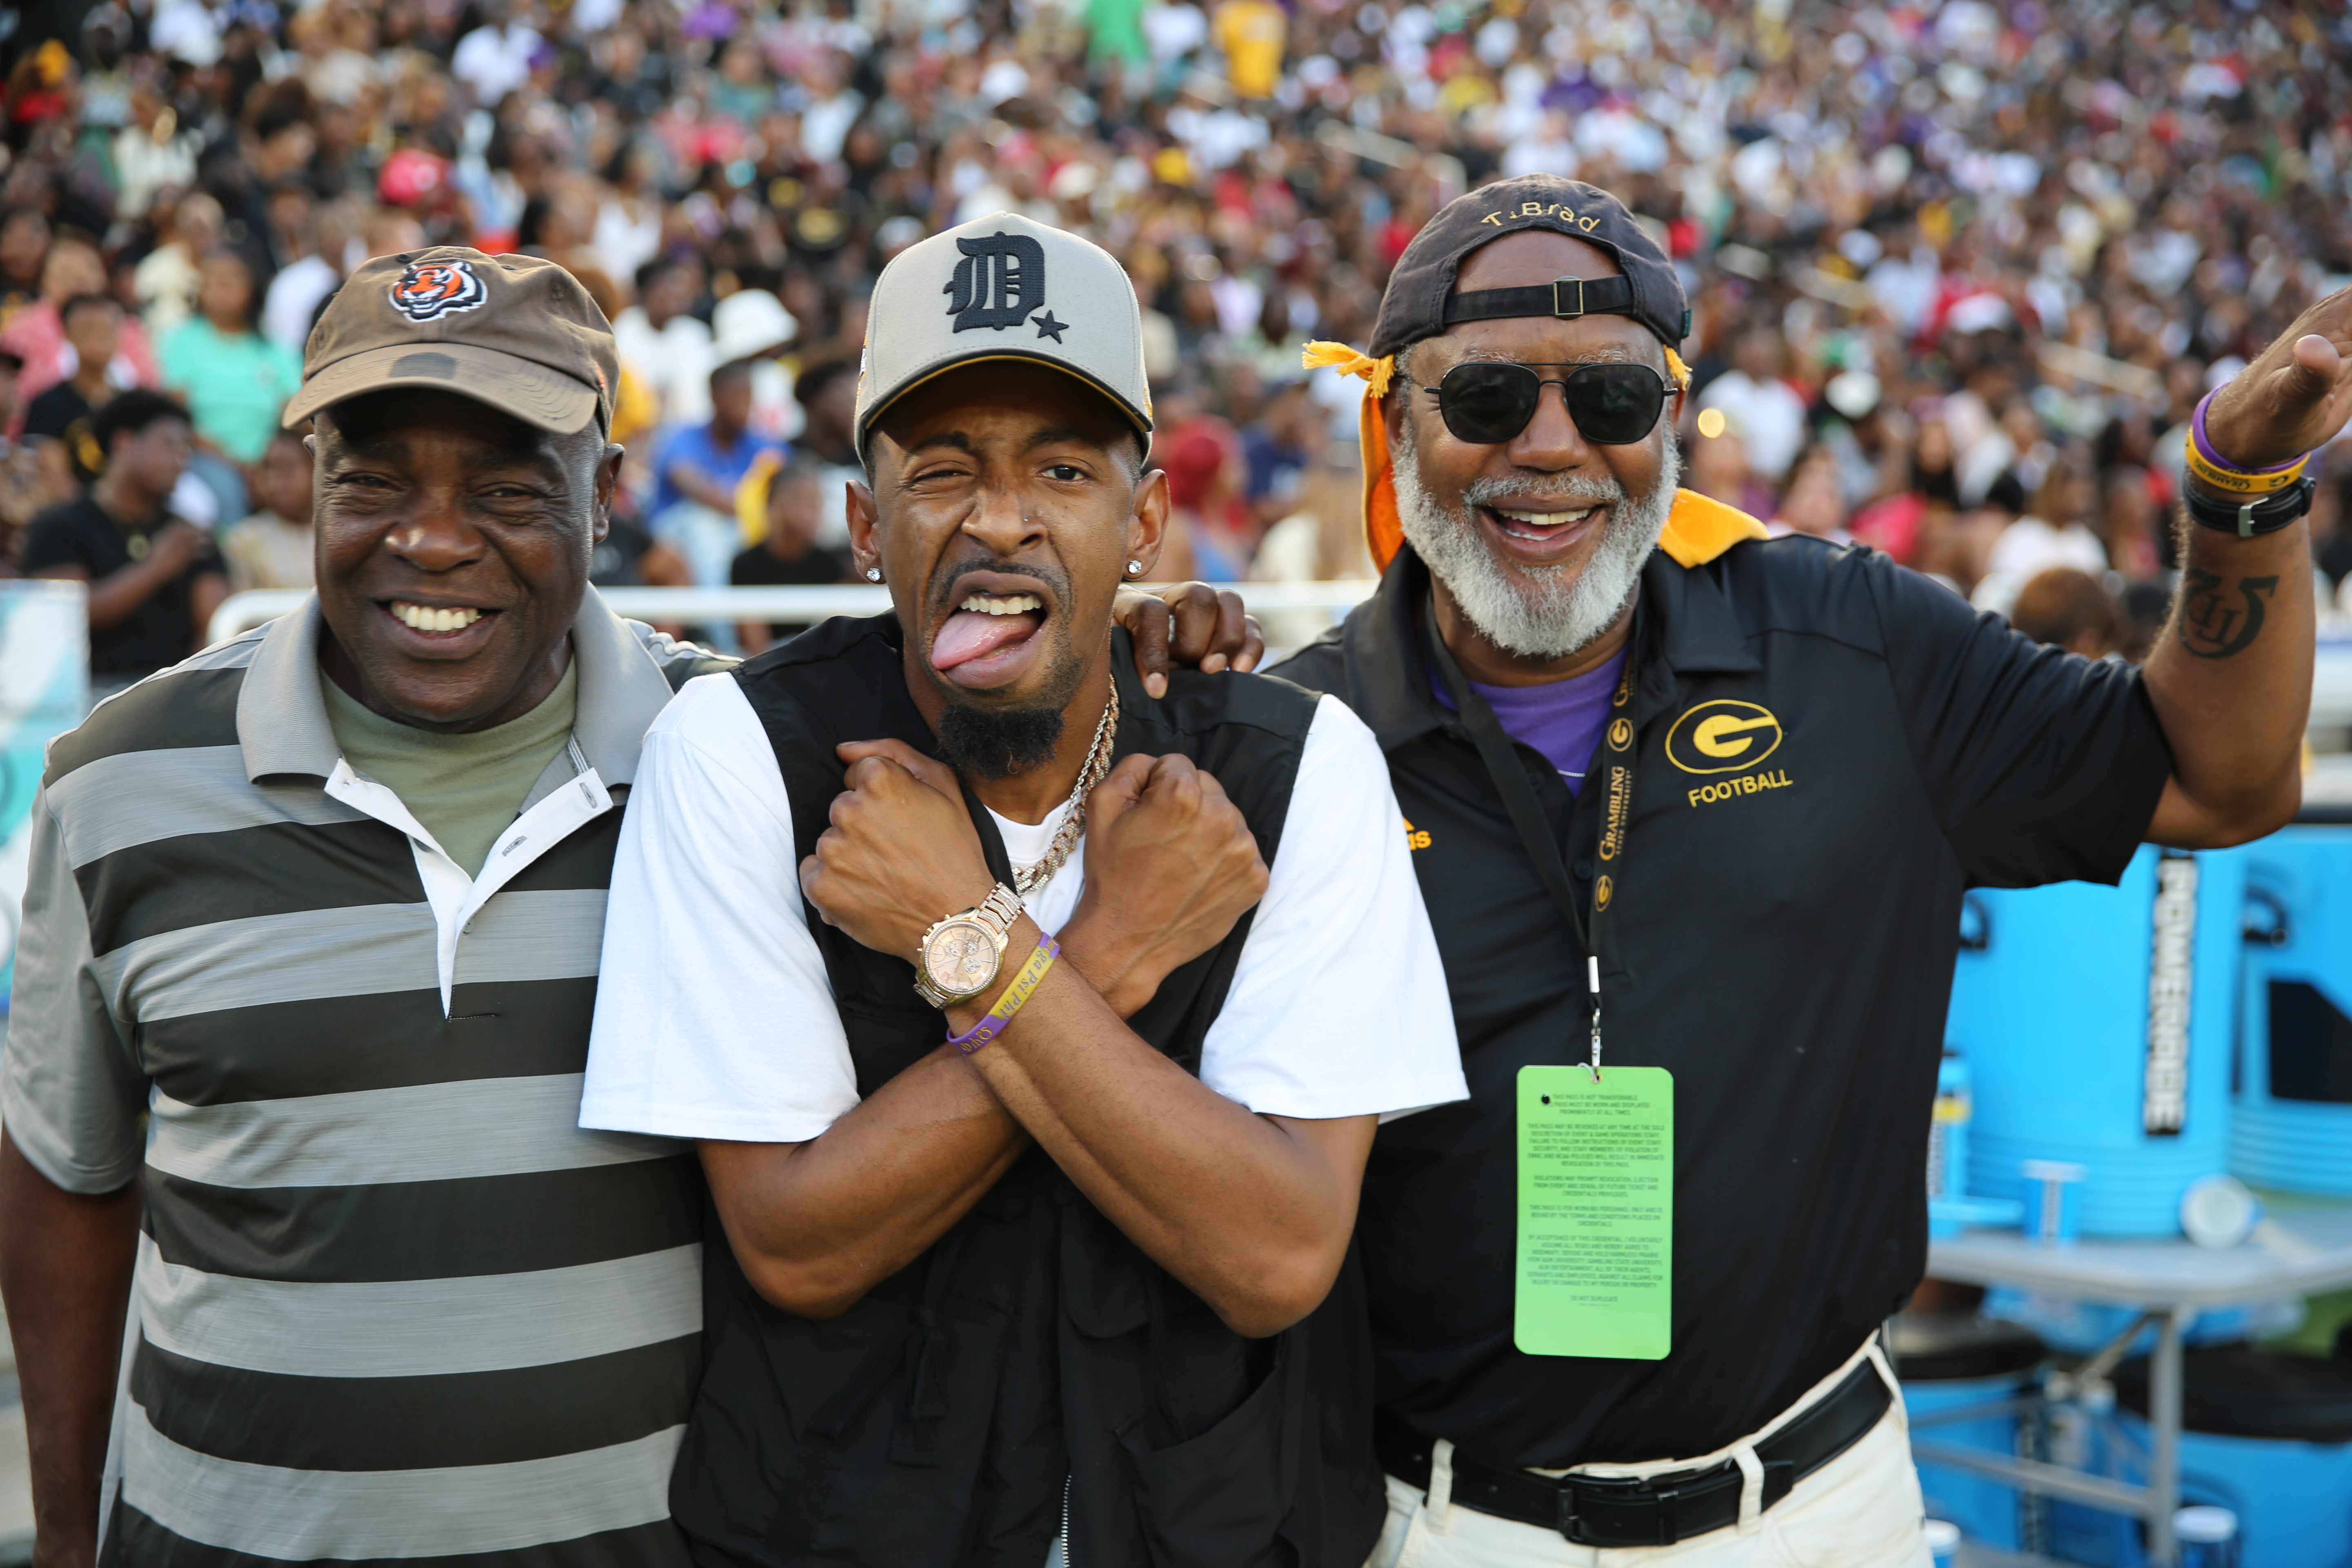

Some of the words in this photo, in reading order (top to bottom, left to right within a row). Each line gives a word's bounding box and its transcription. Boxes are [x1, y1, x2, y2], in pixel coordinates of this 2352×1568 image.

[943, 231, 1045, 334] D
[1688, 769, 1793, 808] FOOTBALL
[1599, 766, 1625, 861] GRAMBLING
[1017, 969, 1038, 995] Psi
[999, 991, 1021, 1020] Phi
